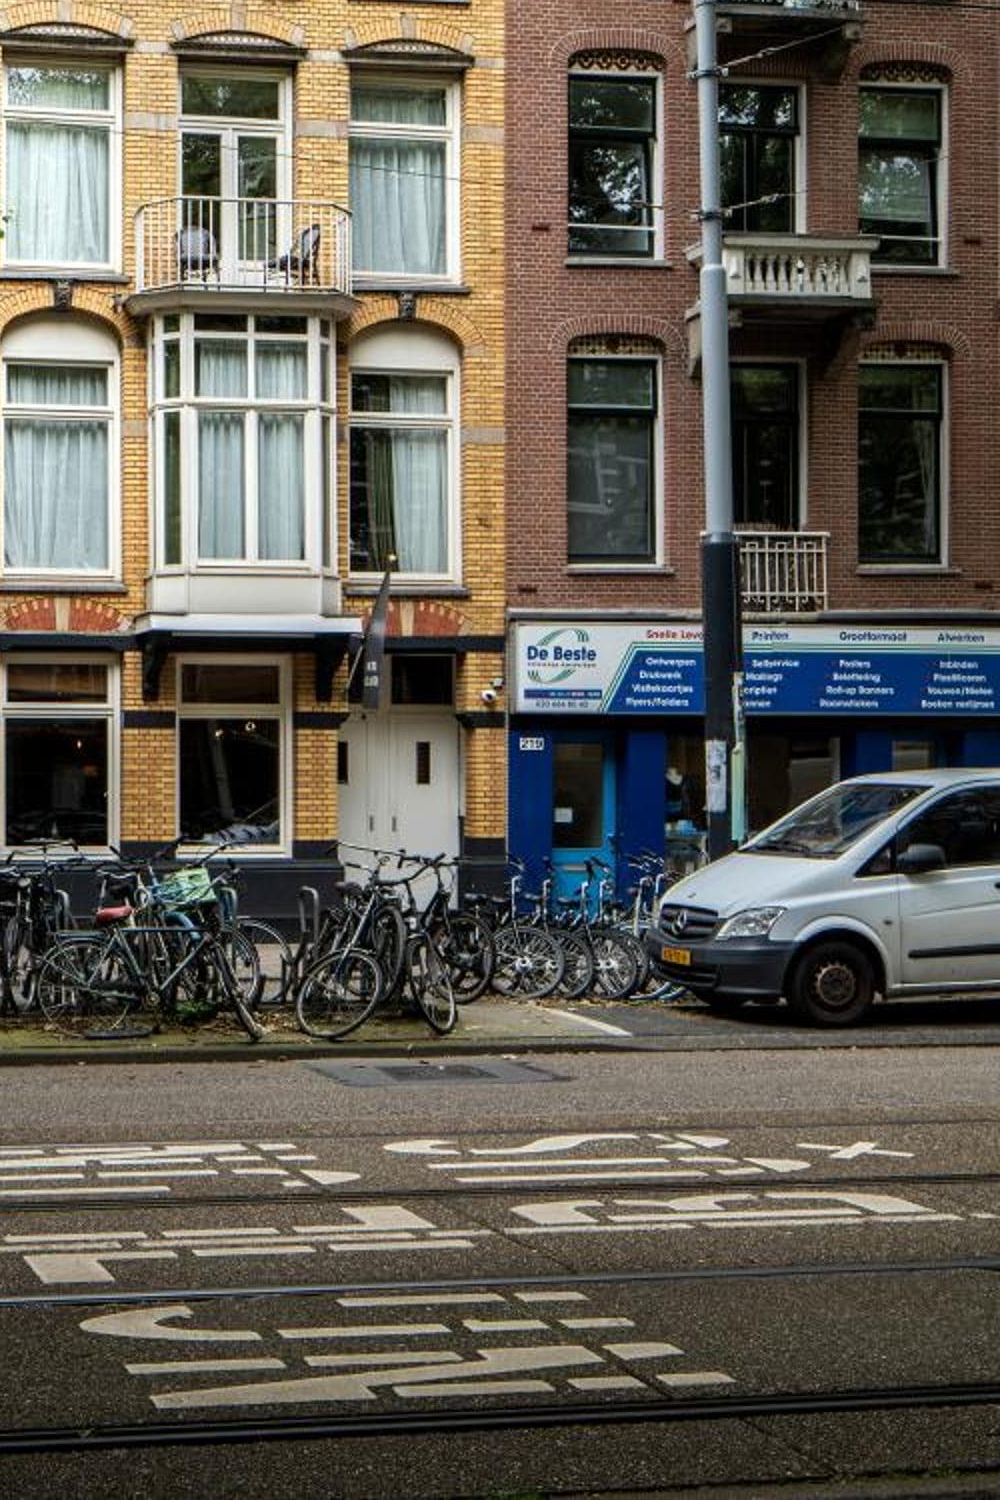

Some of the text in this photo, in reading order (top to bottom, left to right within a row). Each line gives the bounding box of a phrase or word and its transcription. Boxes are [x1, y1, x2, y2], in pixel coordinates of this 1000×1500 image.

[839, 631, 907, 641] Grootformaat
[527, 645, 597, 661] De Beste
[839, 659, 871, 668] Posters
